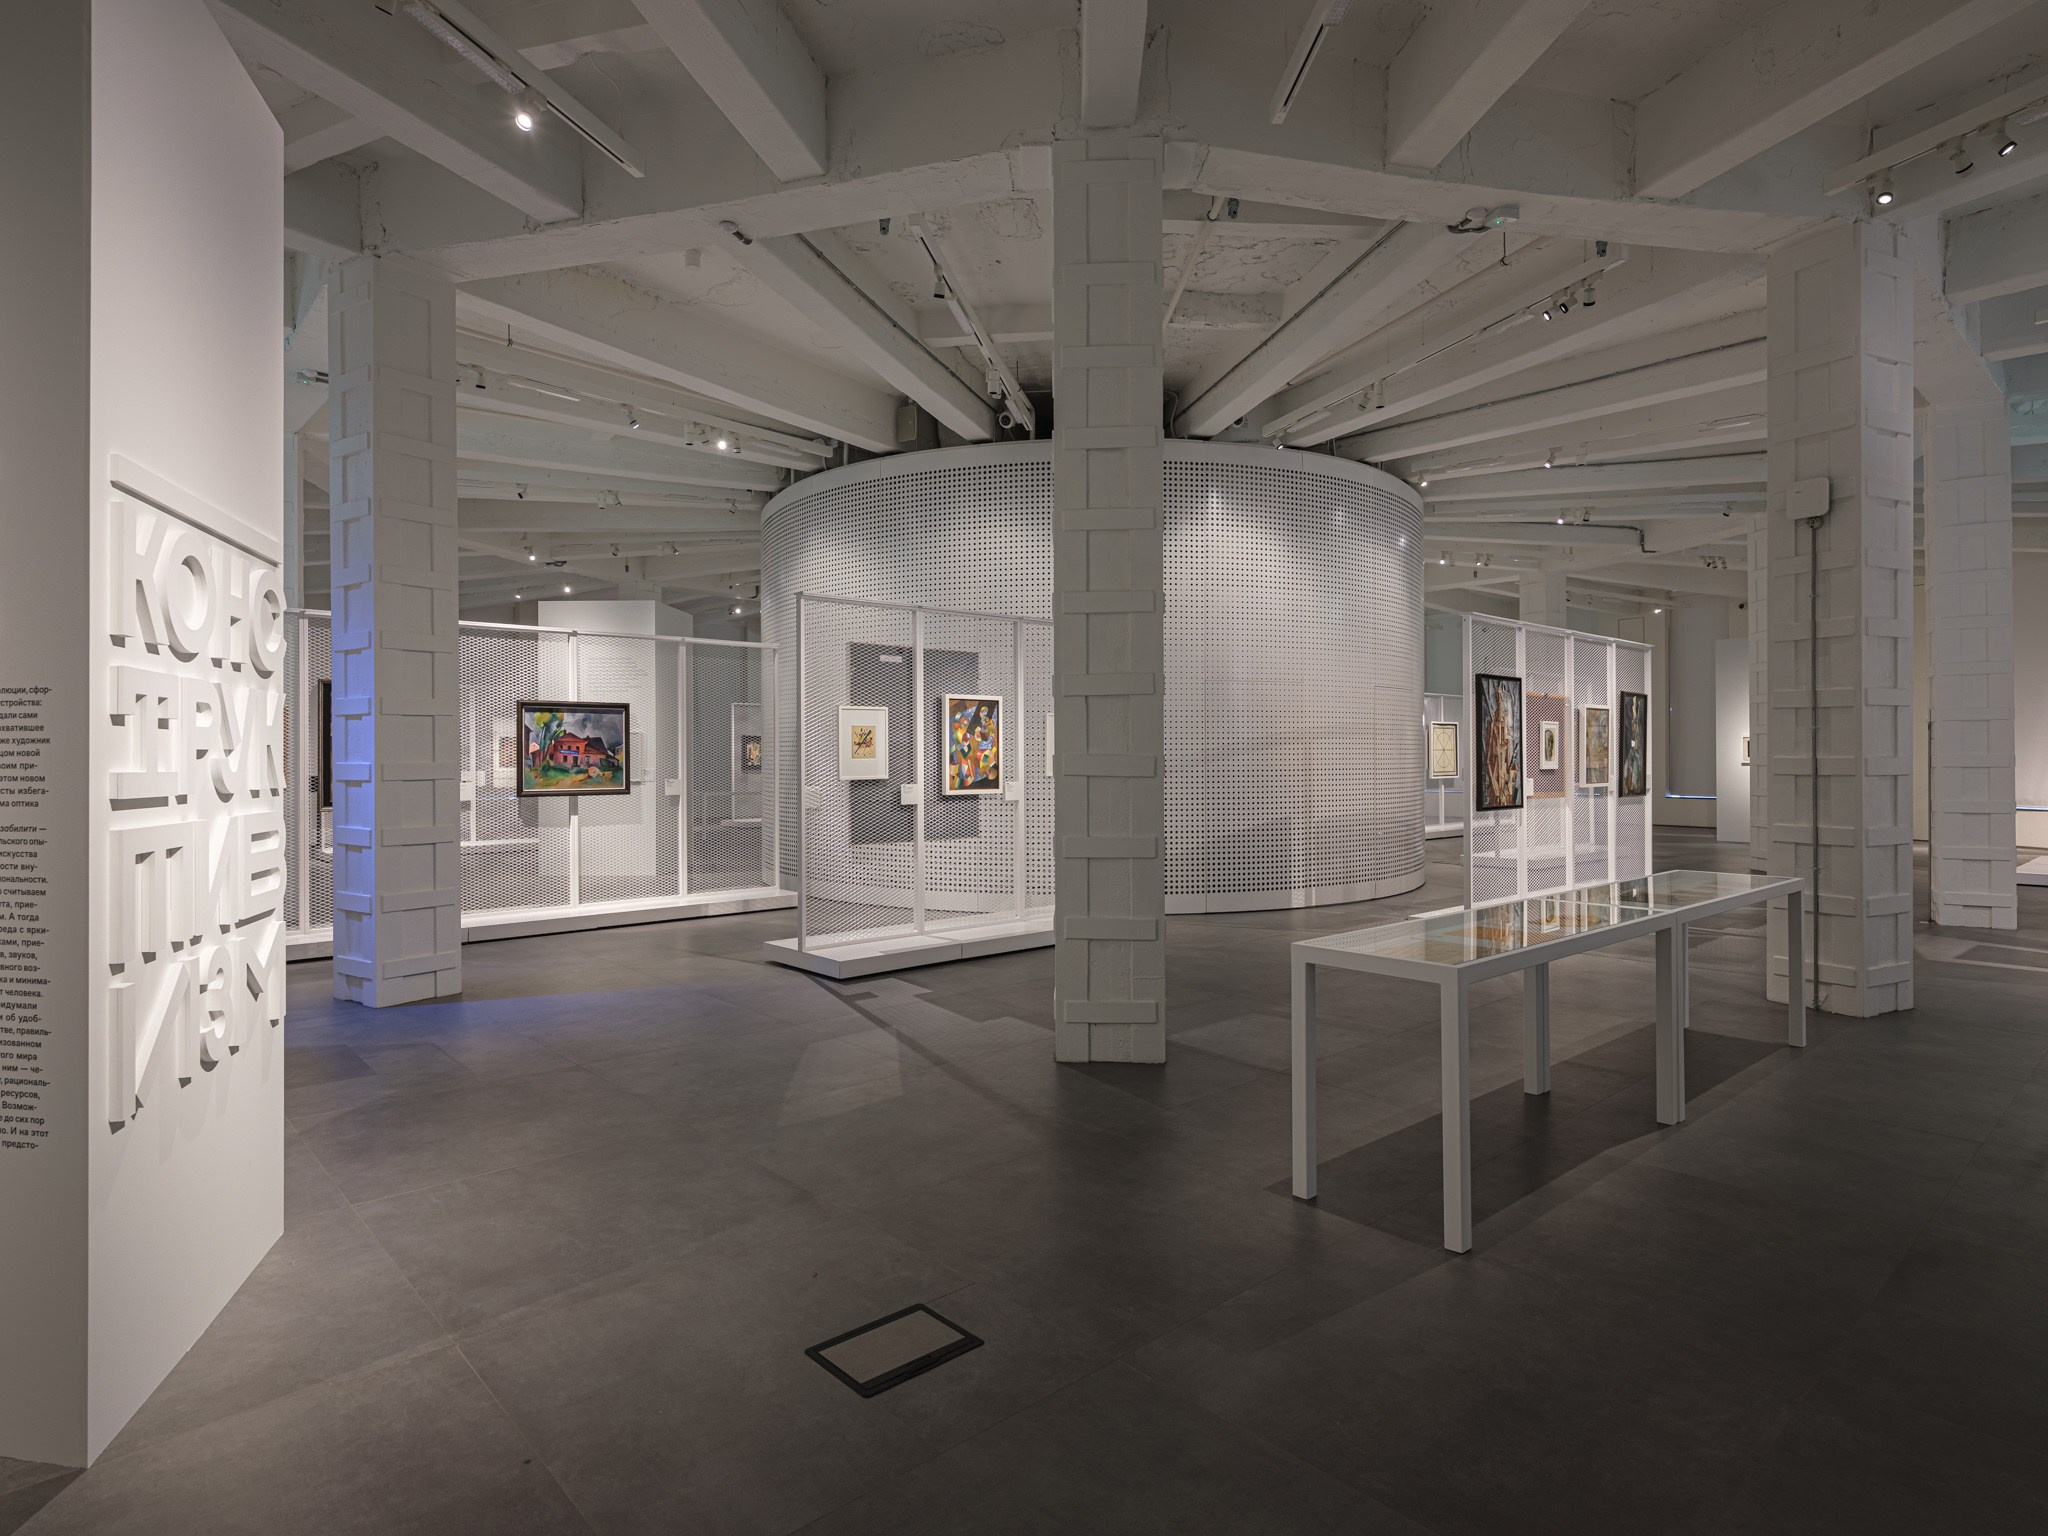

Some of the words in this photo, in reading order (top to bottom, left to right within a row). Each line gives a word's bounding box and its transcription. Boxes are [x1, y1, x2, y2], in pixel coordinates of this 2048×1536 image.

[0, 687, 28, 695] люции,
[29, 685, 52, 695] сфор-
[12, 738, 51, 746] художник
[16, 749, 40, 757] новой
[20, 763, 38, 771] при-
[17, 786, 50, 795] избега-
[29, 838, 48, 846] опы-
[20, 864, 38, 872] вну-
[0, 876, 49, 884] ональности.
[3, 888, 47, 896] считываем
[14, 901, 38, 910] прие-
[9, 912, 15, 920] А
[17, 914, 40, 922] тогда
[26, 927, 50, 936] ярки-
[21, 940, 45, 948] прие-
[8, 952, 38, 961] звуков,
[15, 977, 51, 985] минима-
[5, 1013, 16, 1021] об
[18, 1014, 42, 1024] удоб-
[16, 1027, 52, 1036] правиль-
[16, 1053, 38, 1062] мира
[30, 1066, 44, 1074] че-
[4, 1077, 51, 1087] рациональ-
[0, 1090, 41, 1100] ресурсов,
[2, 1100, 38, 1111] Возмож-
[4, 1115, 14, 1123] до
[15, 1116, 29, 1124] сих
[30, 1117, 45, 1126] пор
[10, 1126, 17, 1135] И
[31, 1130, 49, 1138] этот
[2, 1140, 39, 1150] предсто-
